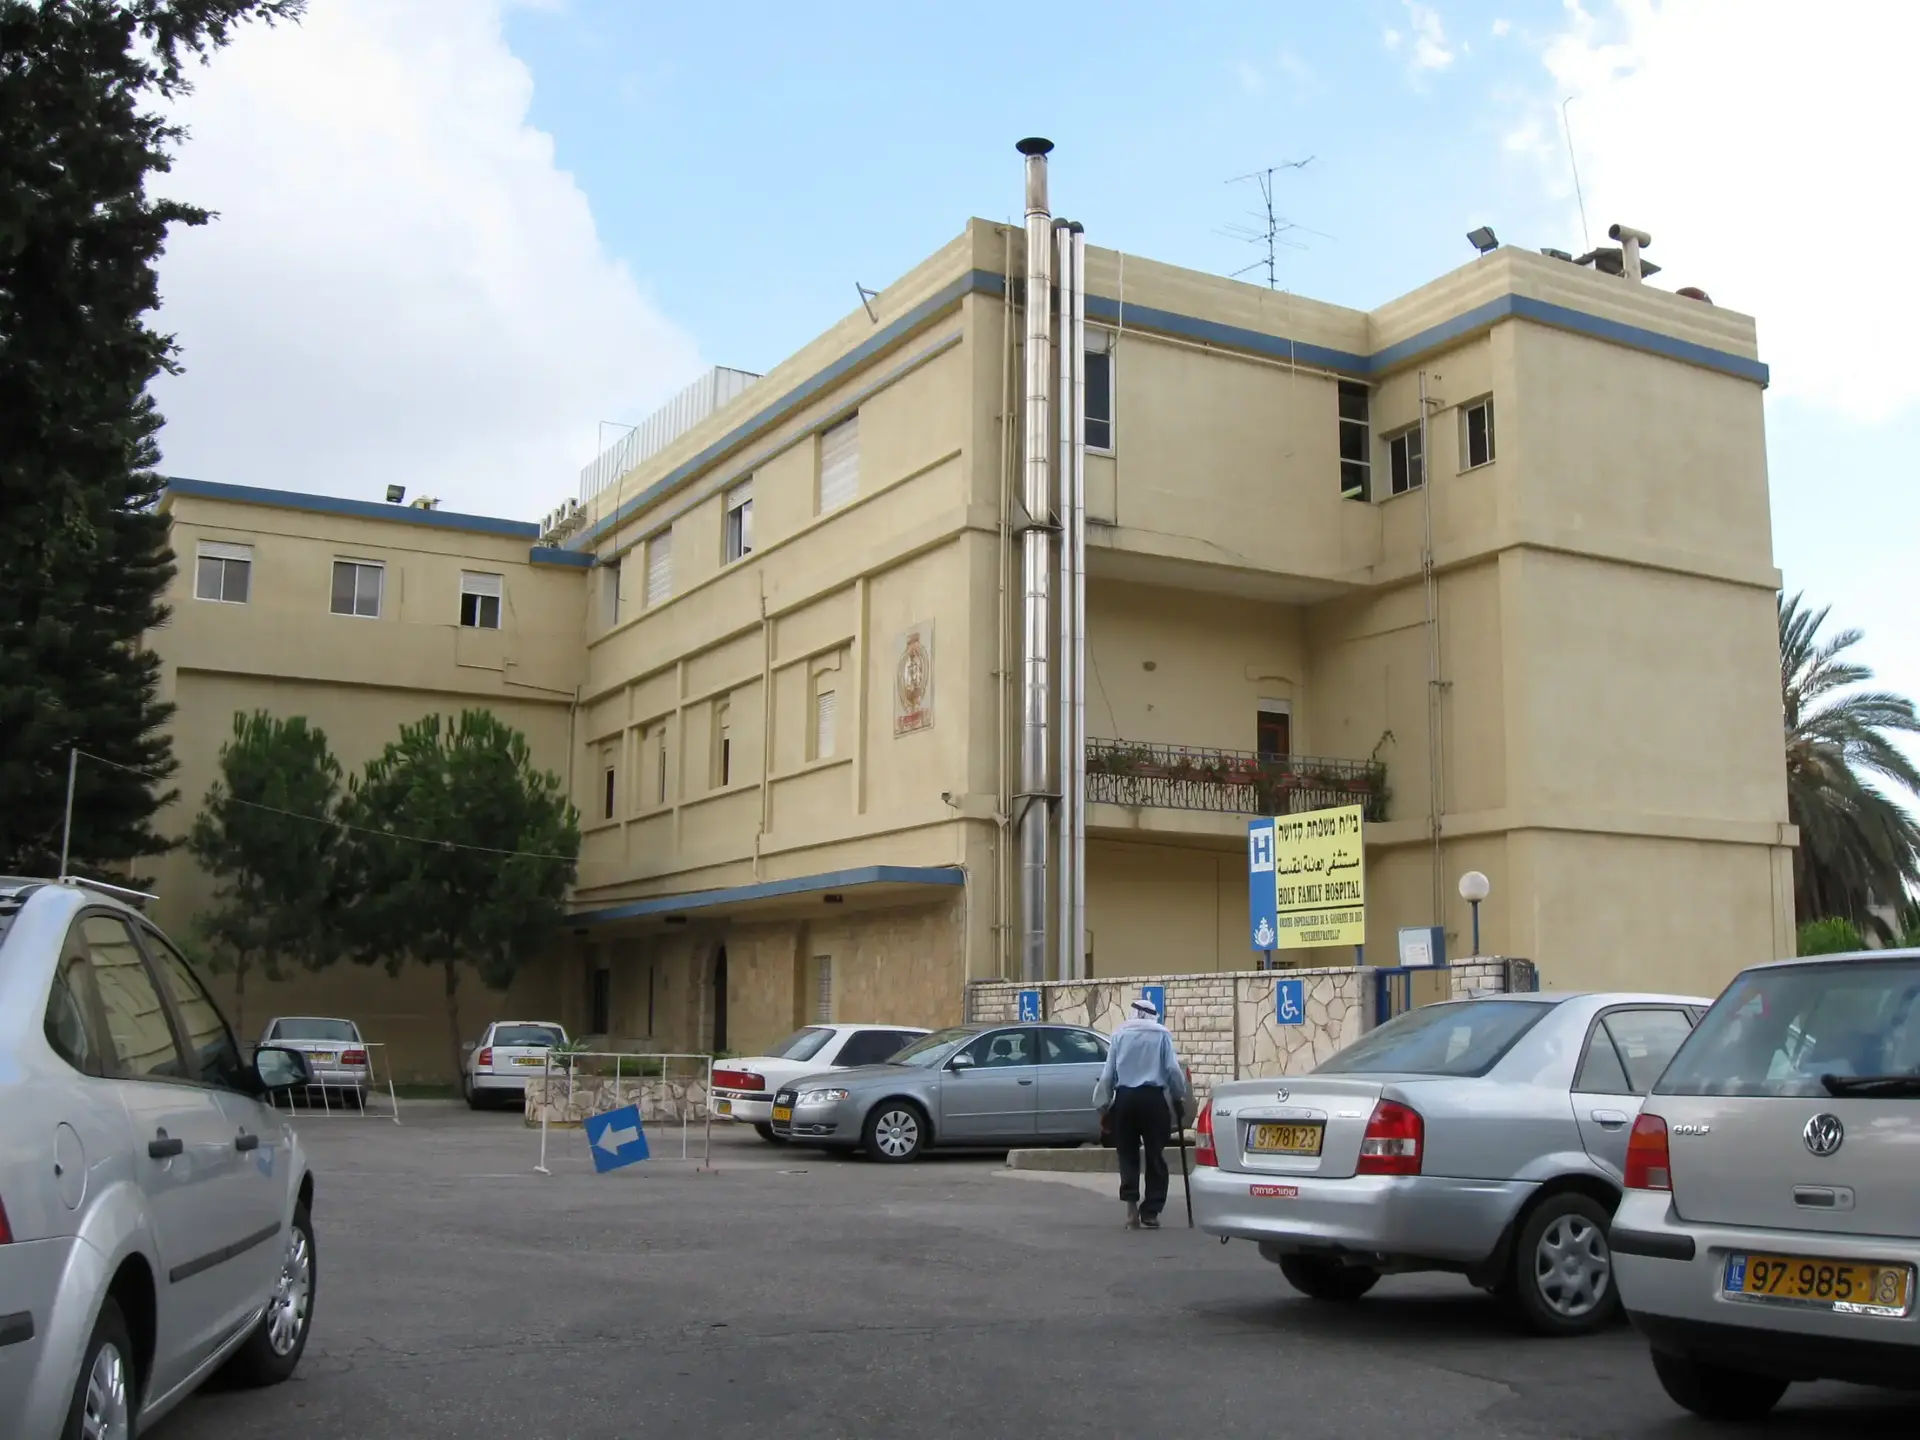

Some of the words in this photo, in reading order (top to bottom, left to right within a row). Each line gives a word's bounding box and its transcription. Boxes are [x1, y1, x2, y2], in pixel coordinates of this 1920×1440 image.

[1253, 834, 1270, 865] H
[1278, 886, 1296, 905] HOLY
[1298, 884, 1323, 903] FAMILY
[1325, 880, 1361, 901] HOSPITAL
[1672, 1124, 1711, 1136] GOLF
